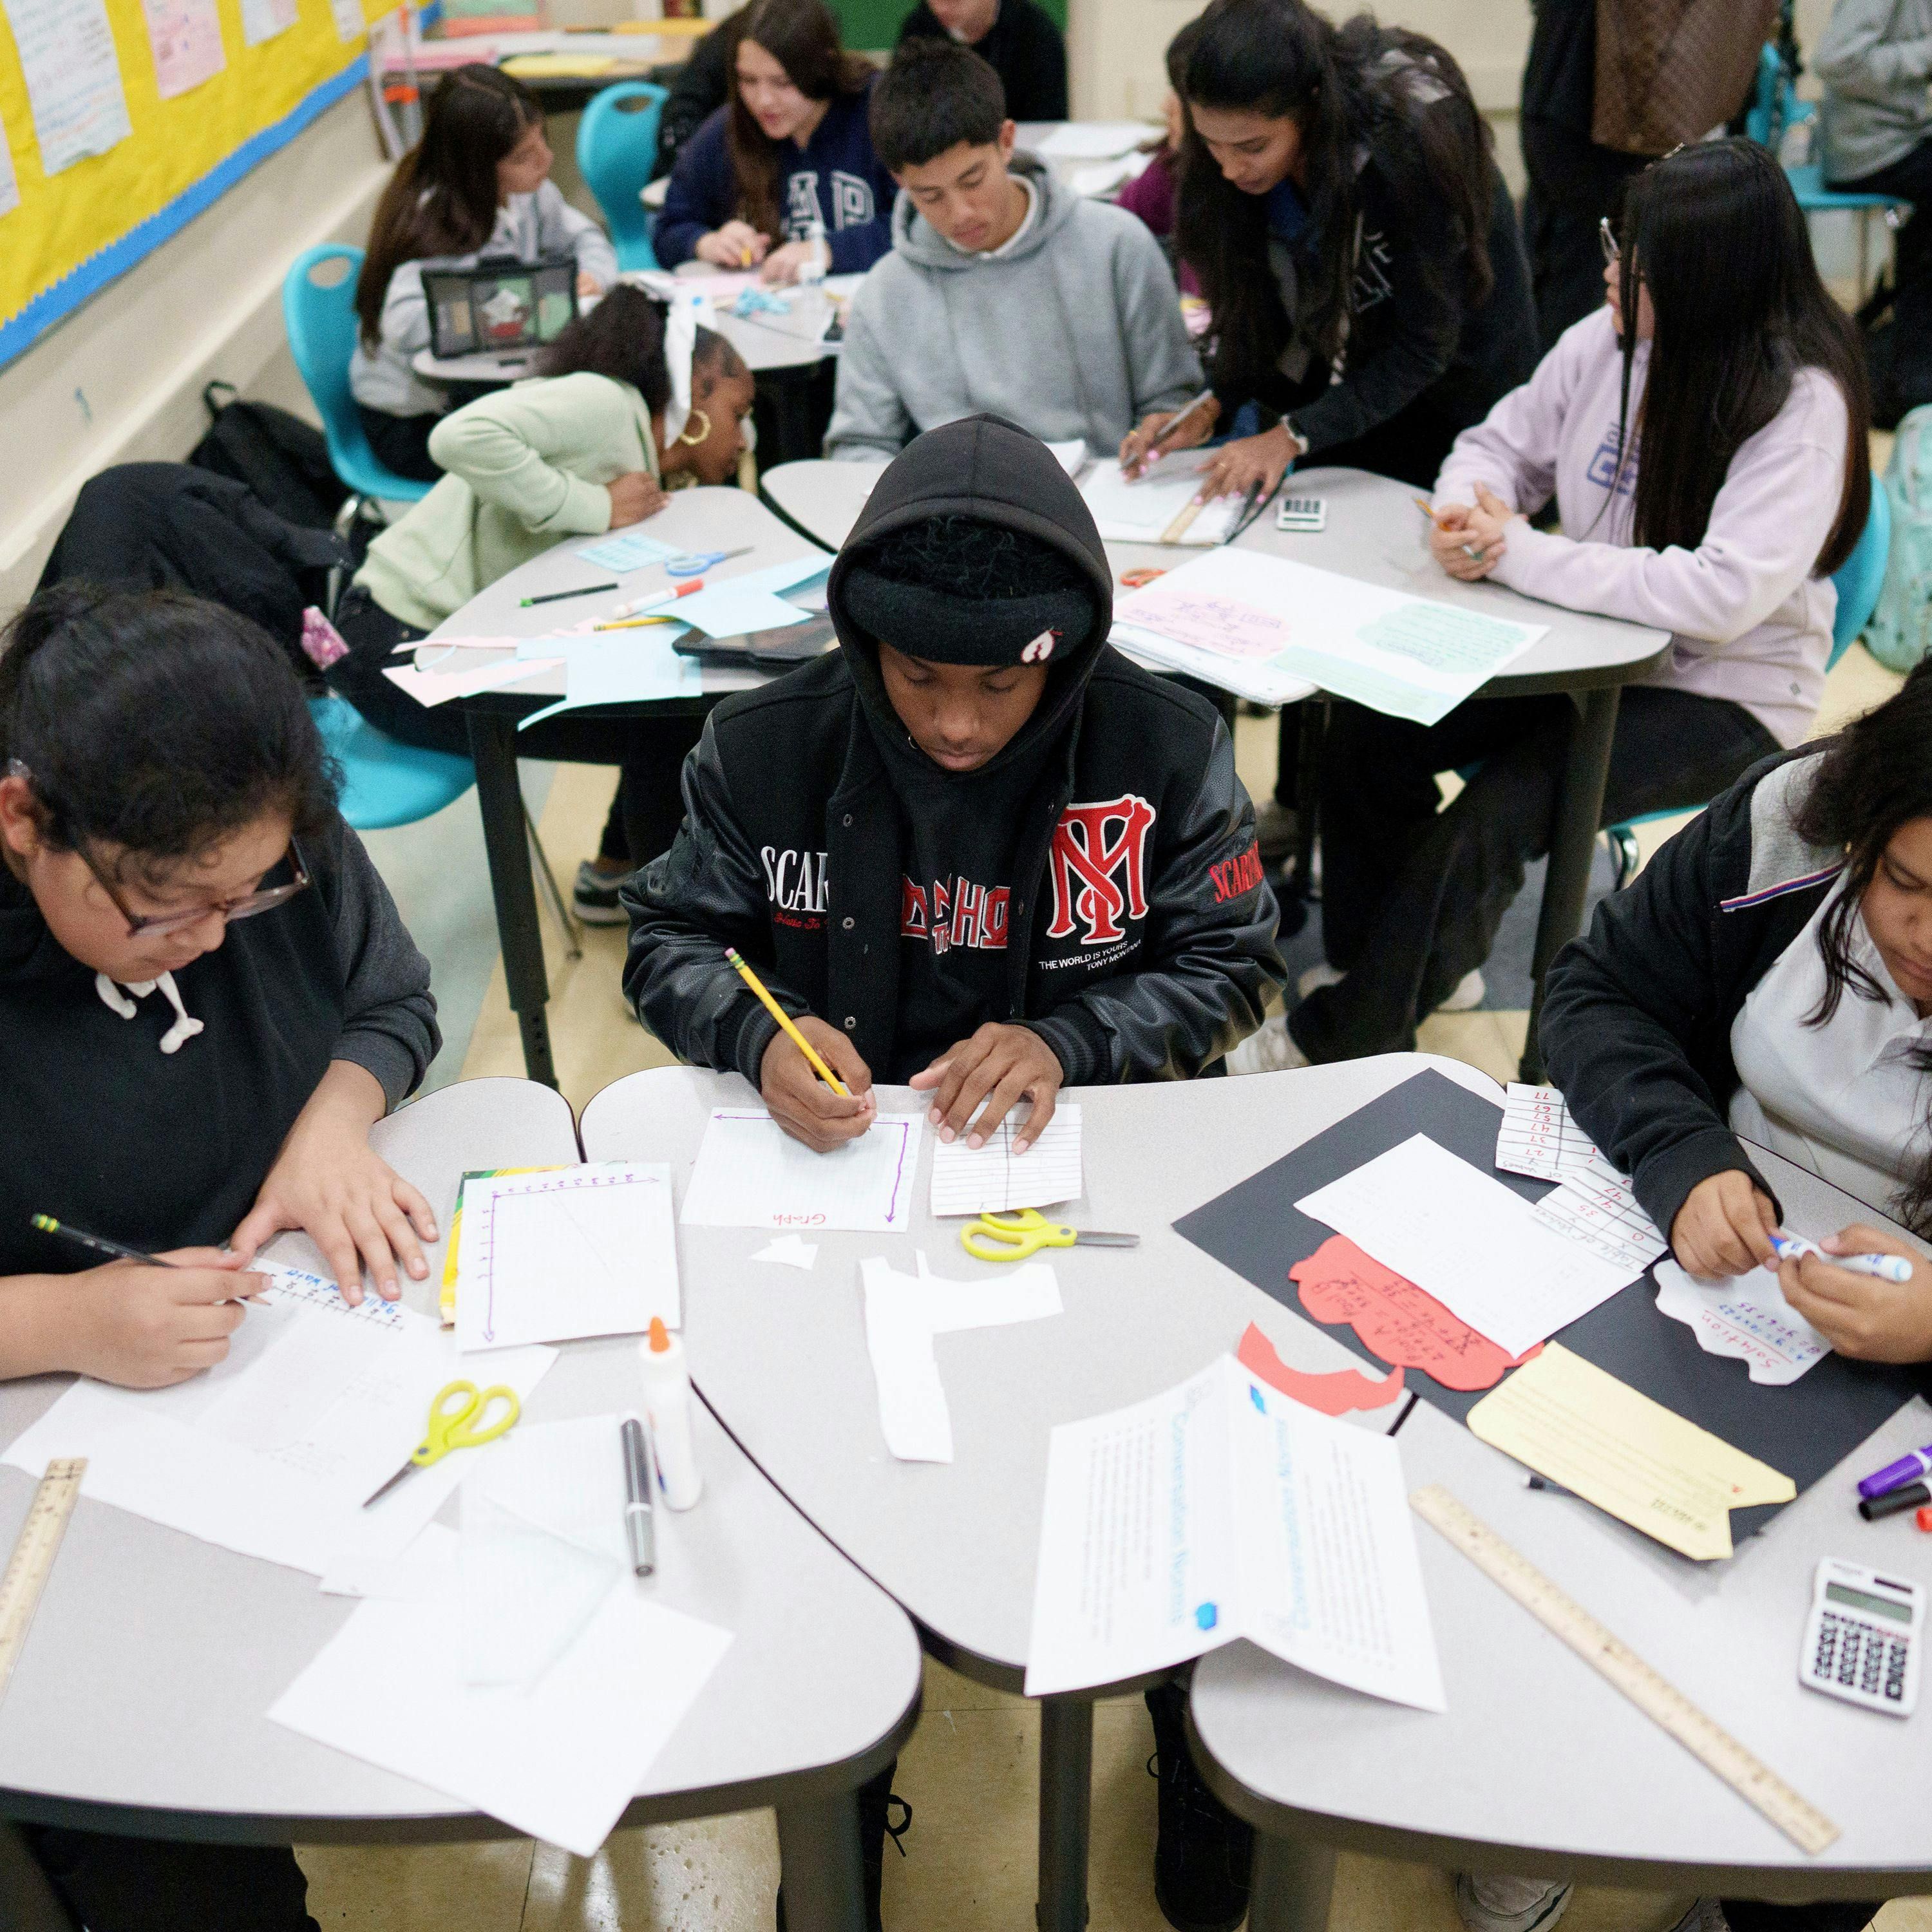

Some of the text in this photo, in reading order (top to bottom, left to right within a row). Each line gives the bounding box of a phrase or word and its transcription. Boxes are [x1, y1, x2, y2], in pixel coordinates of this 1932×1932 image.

[1039, 960, 1058, 970] THE
[1059, 954, 1091, 968] WORLD
[1103, 941, 1128, 956] YOURS
[1086, 939, 1141, 971] TONY MONTANA
[1534, 1113, 1550, 1122] 57
[1531, 1124, 1549, 1133] 47
[1530, 1135, 1545, 1144] 37
